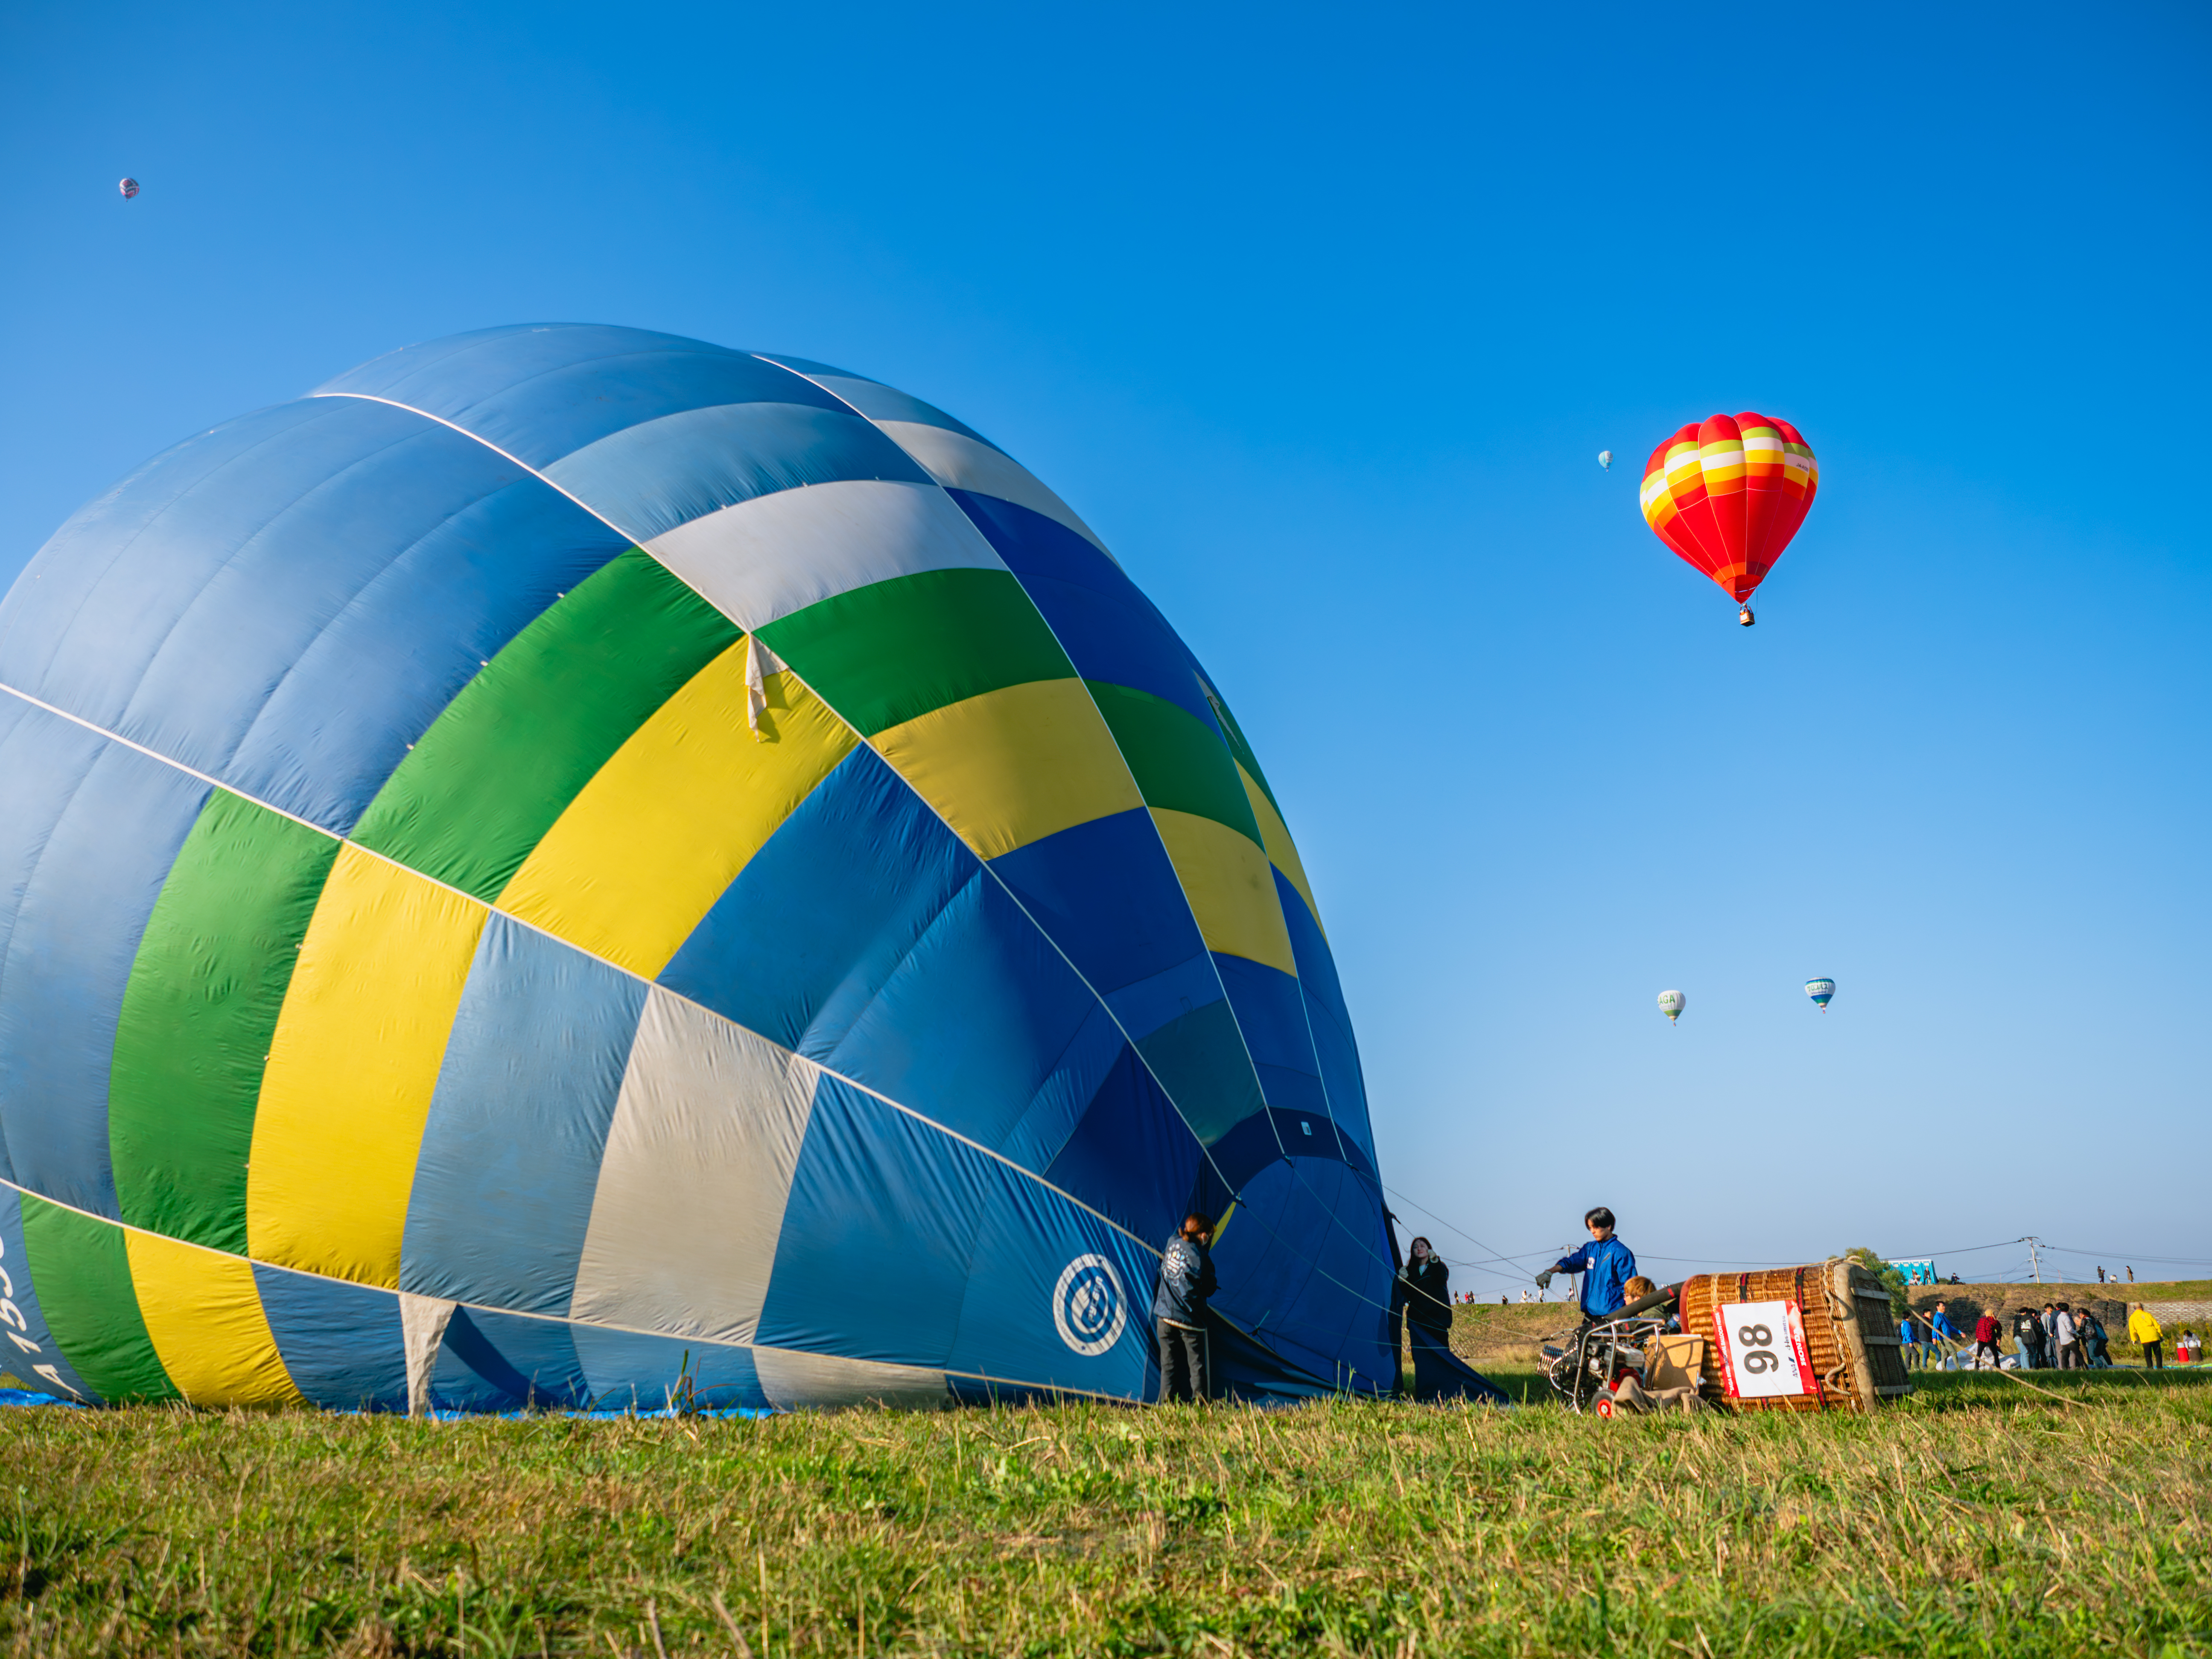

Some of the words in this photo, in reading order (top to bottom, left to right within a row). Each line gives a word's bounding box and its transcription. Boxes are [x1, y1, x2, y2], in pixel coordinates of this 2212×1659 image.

[1717, 1326, 1726, 1345] BALLOON
[1739, 1324, 1779, 1374] 98
[1783, 1316, 1791, 1350] Hisamitsu
[1793, 1328, 1806, 1366] HONDA
[1722, 1346, 1731, 1378] INTERNATIONAL
